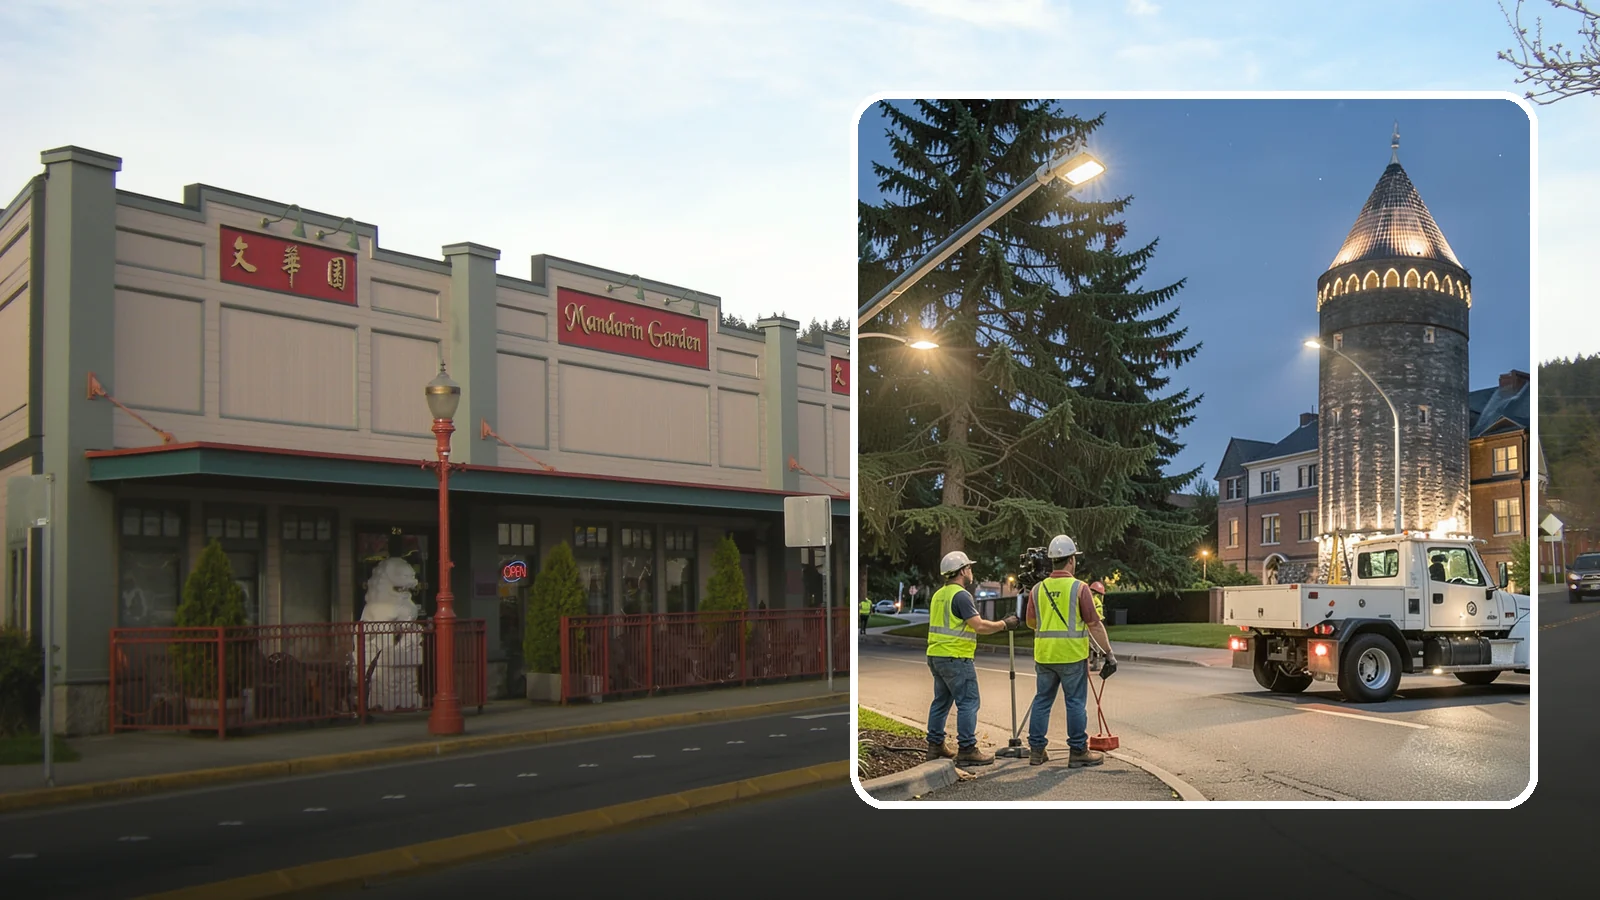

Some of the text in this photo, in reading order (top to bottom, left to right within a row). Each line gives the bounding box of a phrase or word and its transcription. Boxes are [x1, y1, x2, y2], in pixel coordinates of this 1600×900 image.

[231, 236, 346, 290] 文華園
[565, 303, 701, 352] Mandarin Garden
[503, 565, 527, 578] OPEN
